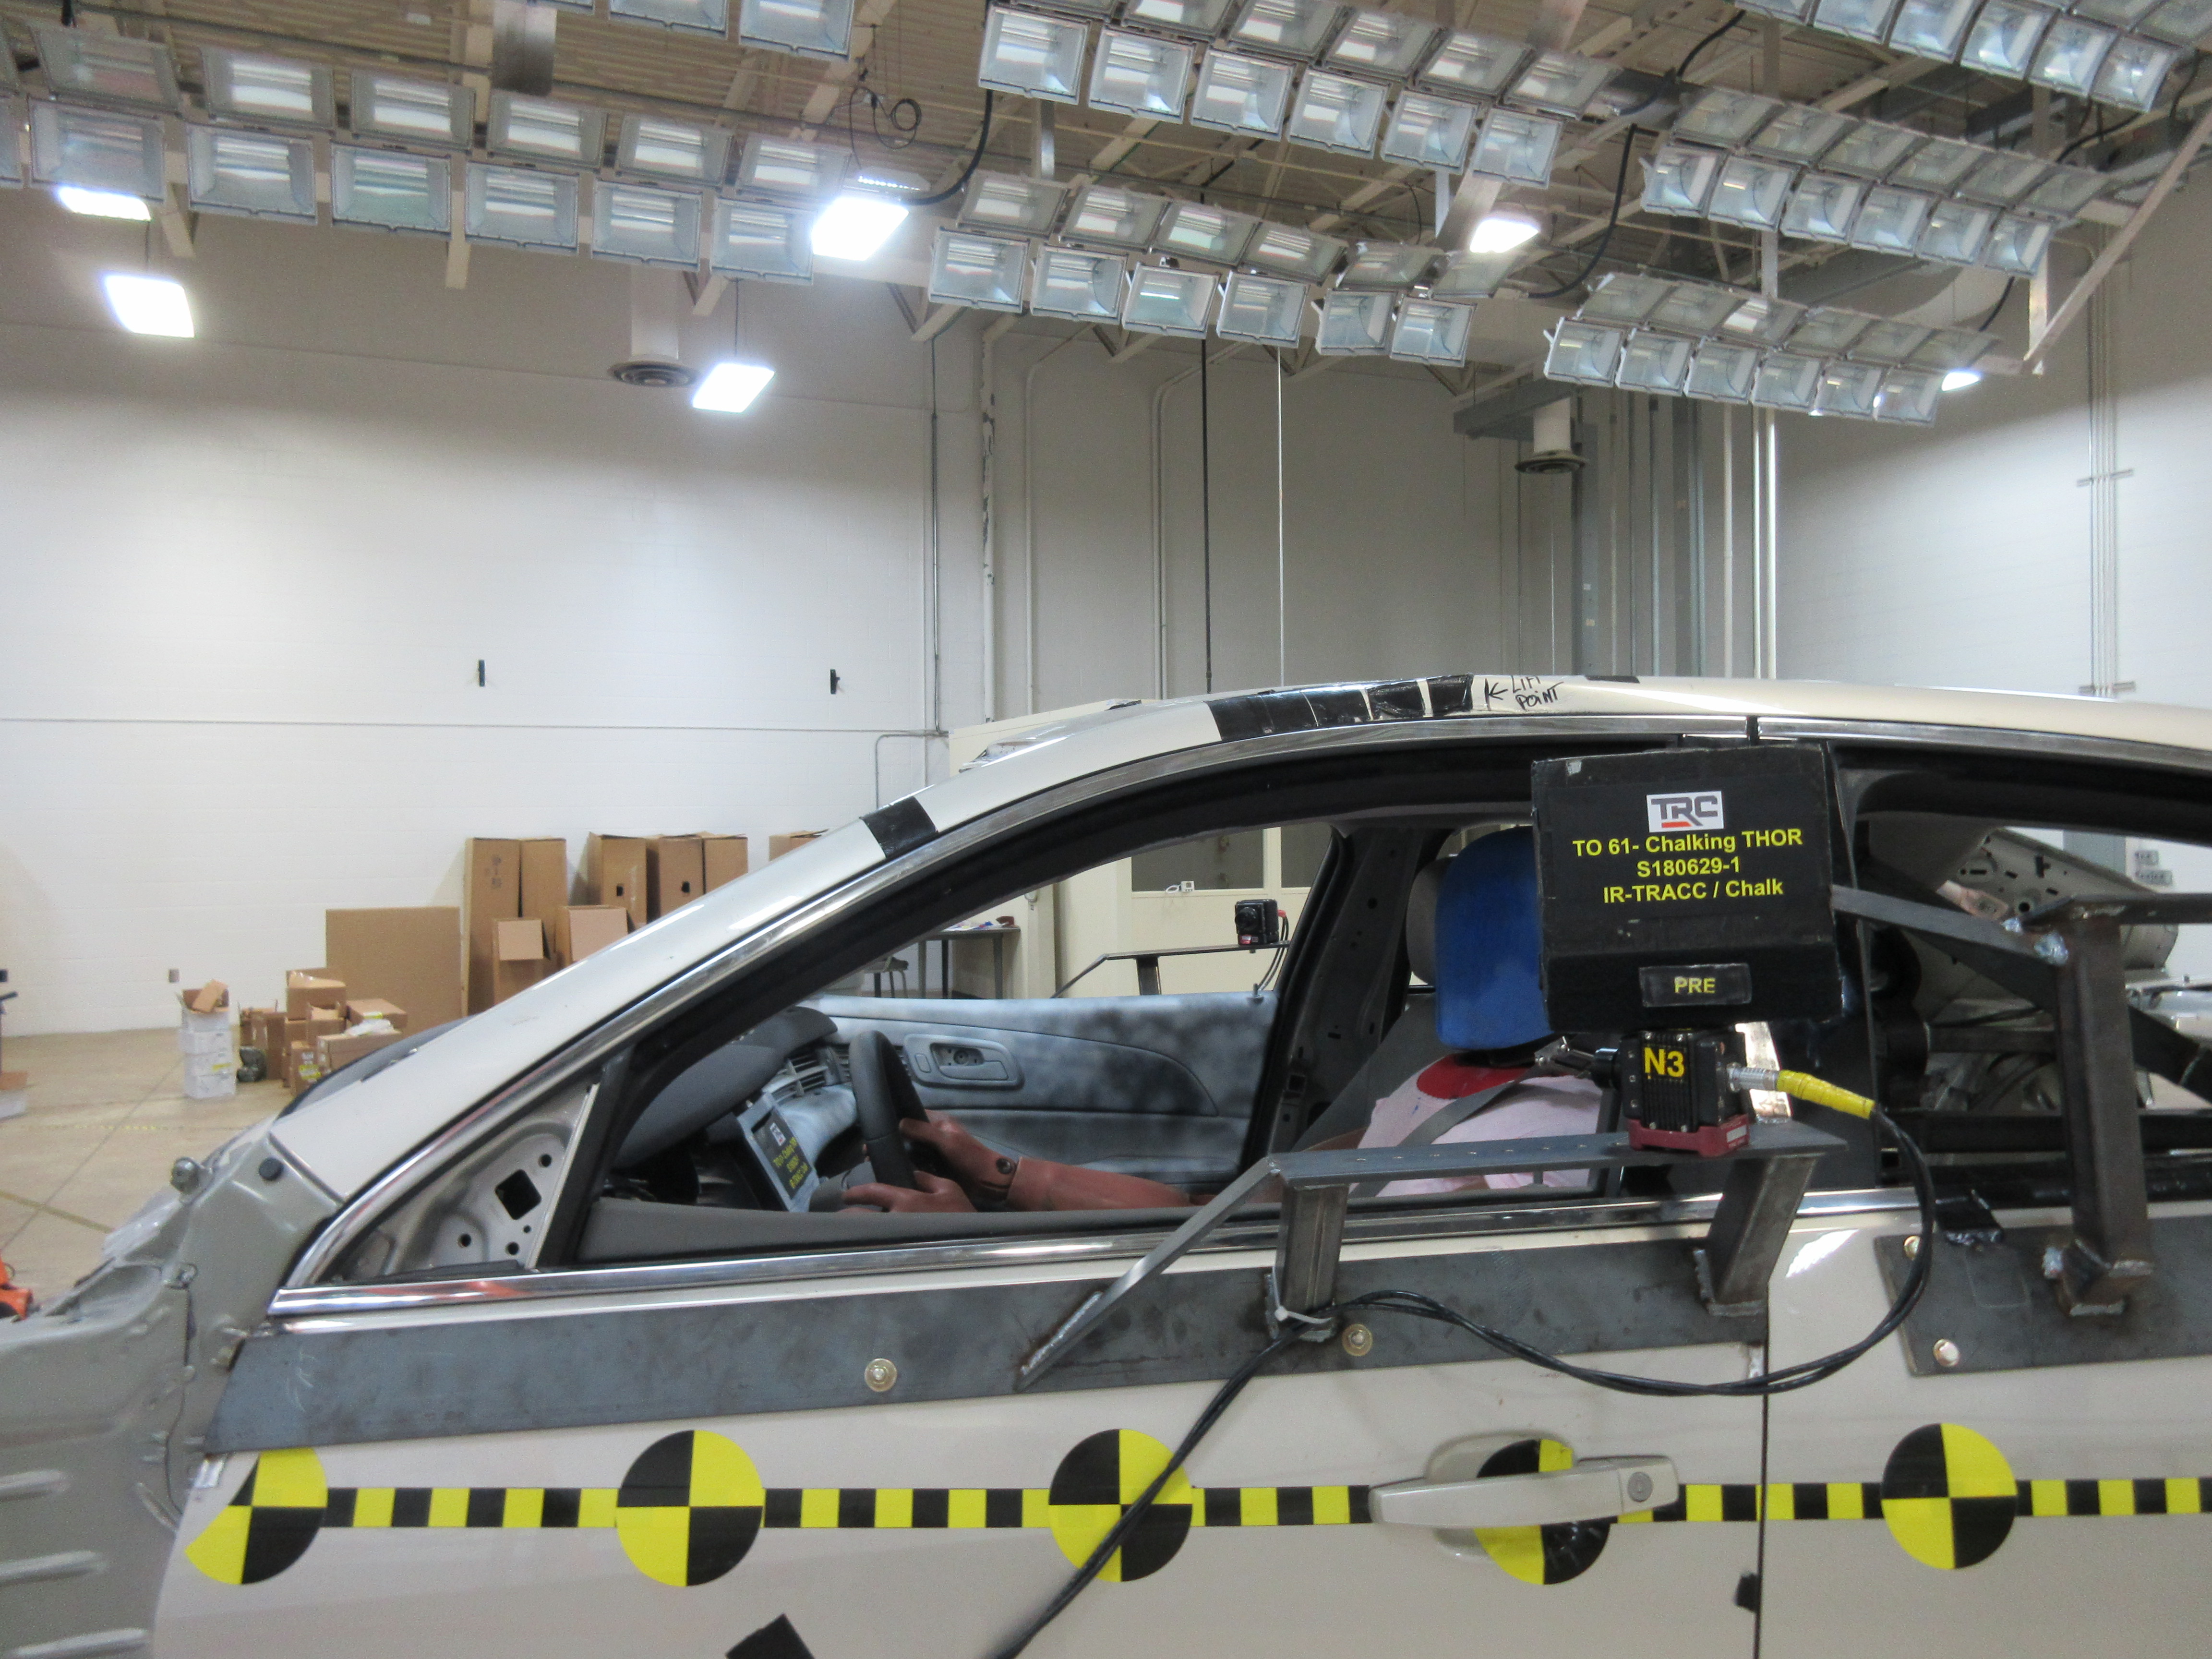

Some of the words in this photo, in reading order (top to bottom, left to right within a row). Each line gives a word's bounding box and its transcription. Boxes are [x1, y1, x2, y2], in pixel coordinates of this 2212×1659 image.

[1651, 795, 1718, 827] TRC
[1572, 839, 1602, 857] TO
[1608, 838, 1639, 855] 61-
[1645, 833, 1736, 853] Chalking
[1742, 828, 1803, 847] THOR
[1637, 856, 1740, 878] S180629-1
[1604, 882, 1707, 903] IR-TRACC
[1713, 881, 1719, 898] /
[1725, 878, 1784, 897] Chalk
[1674, 976, 1716, 993] PRE
[1644, 1046, 1685, 1077] N3
